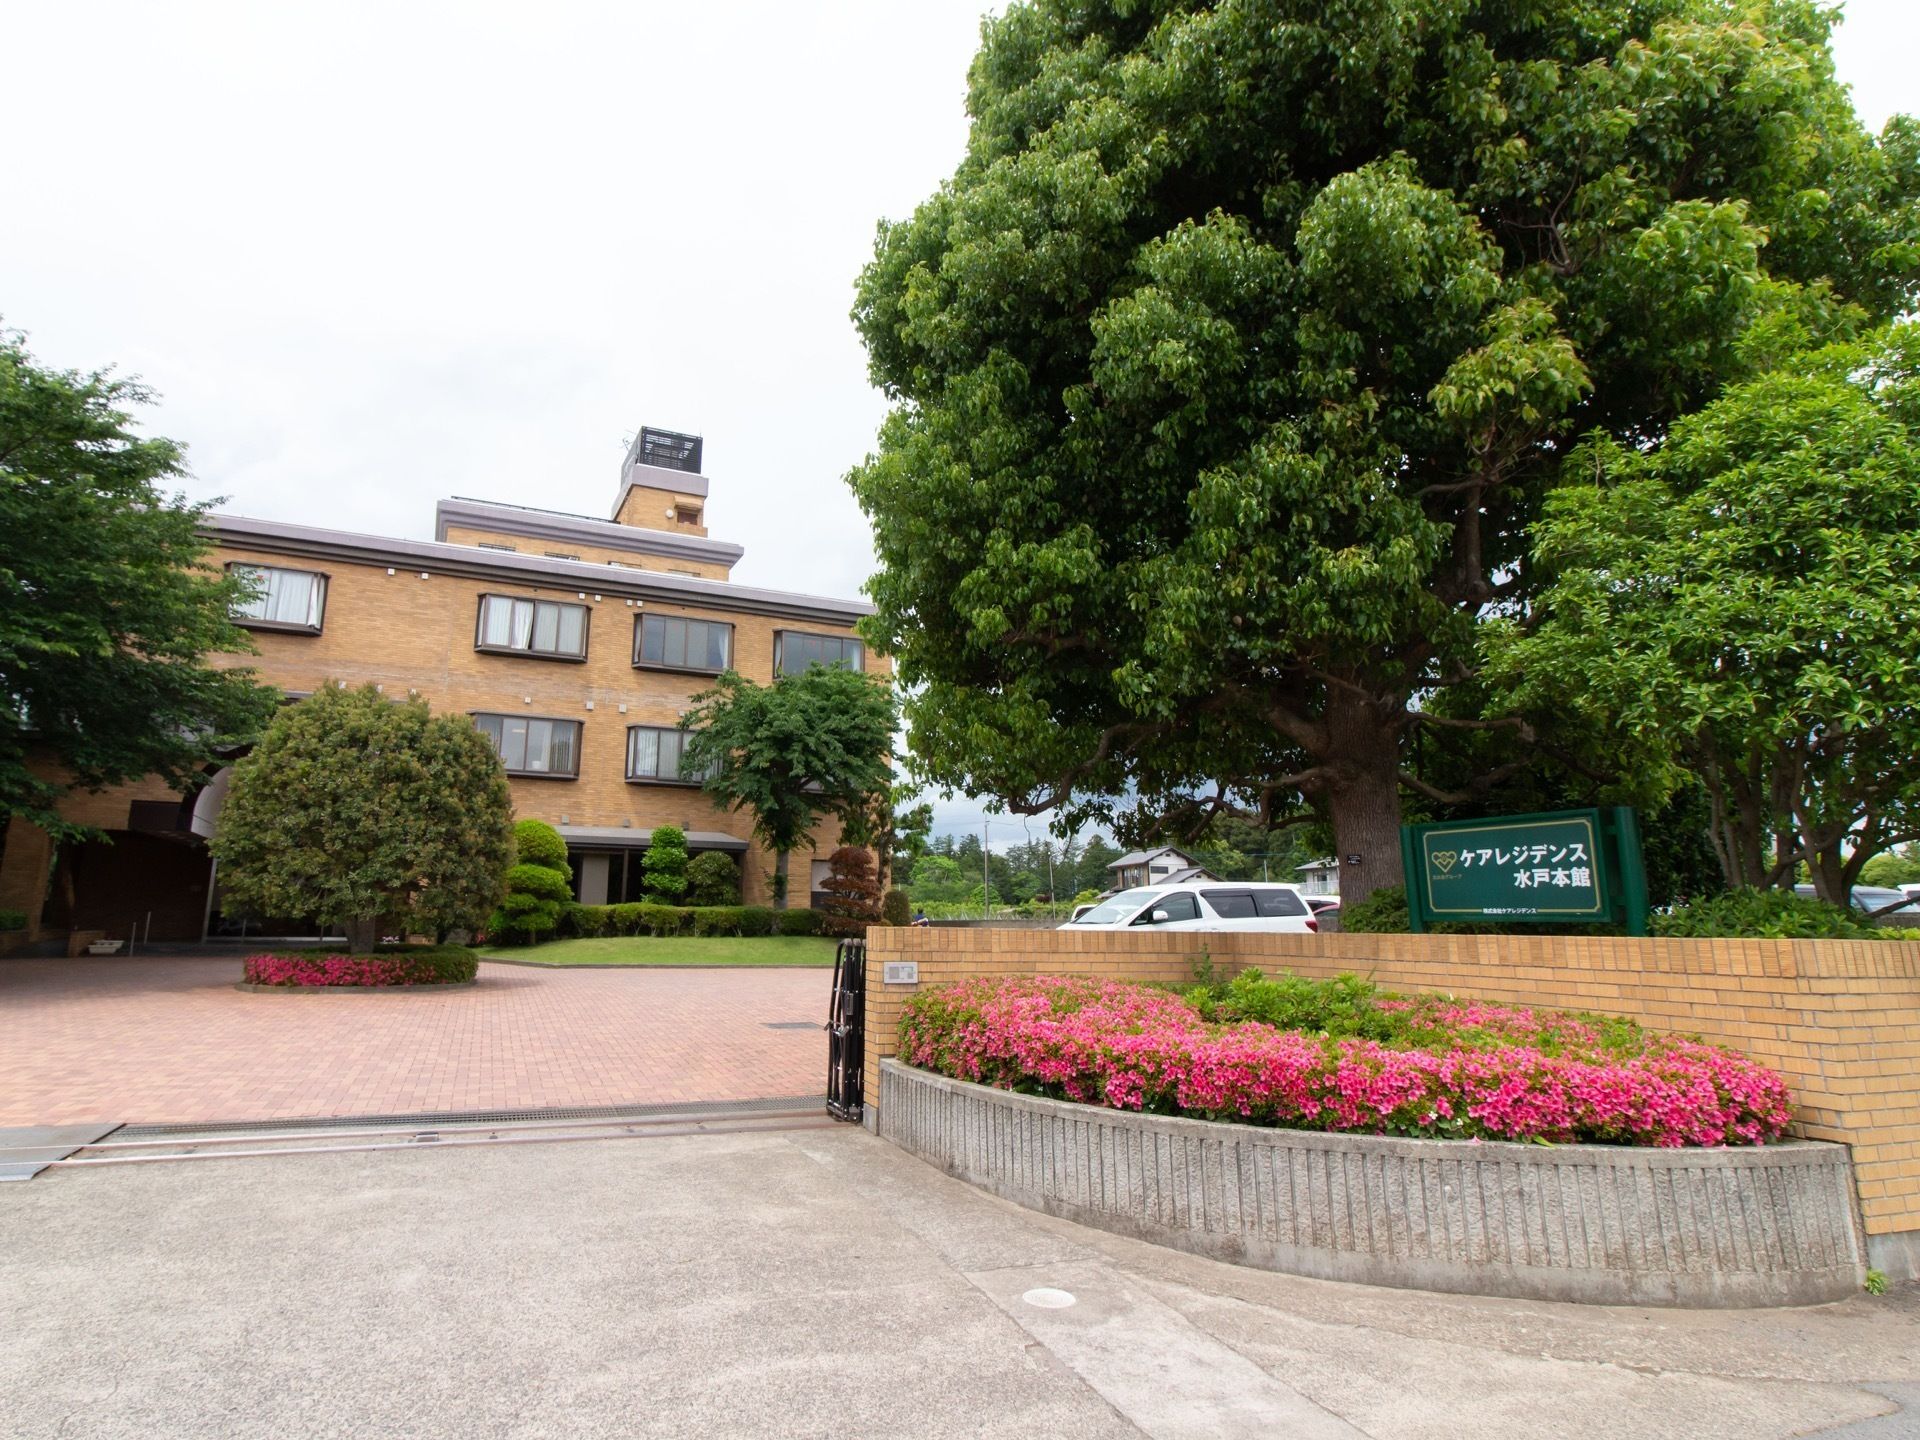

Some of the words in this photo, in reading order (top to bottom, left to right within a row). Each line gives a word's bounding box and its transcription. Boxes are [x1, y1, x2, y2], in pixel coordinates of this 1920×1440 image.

[1460, 843, 1587, 868] ケアレジデンス
[1514, 867, 1590, 888] 水戸本館
